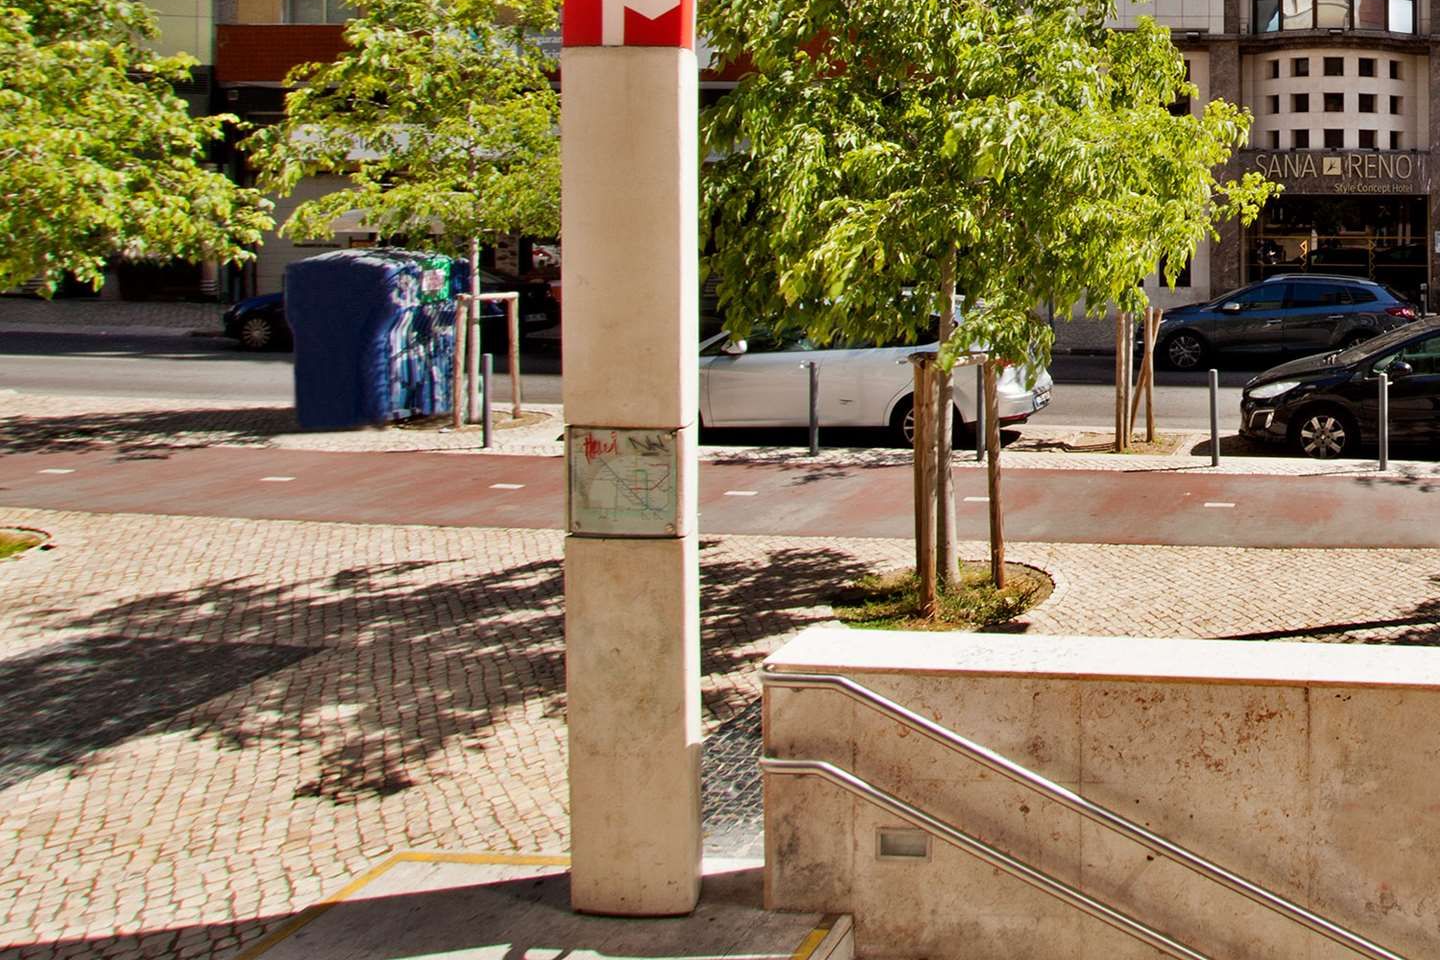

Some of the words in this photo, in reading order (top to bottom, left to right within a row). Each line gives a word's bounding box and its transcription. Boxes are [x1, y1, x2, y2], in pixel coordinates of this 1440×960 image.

[1255, 153, 1318, 178] SANA
[1348, 153, 1413, 179] RENO
[1334, 183, 1356, 193] Style
[1357, 183, 1391, 193] Concept
[1392, 183, 1413, 192] Hotel
